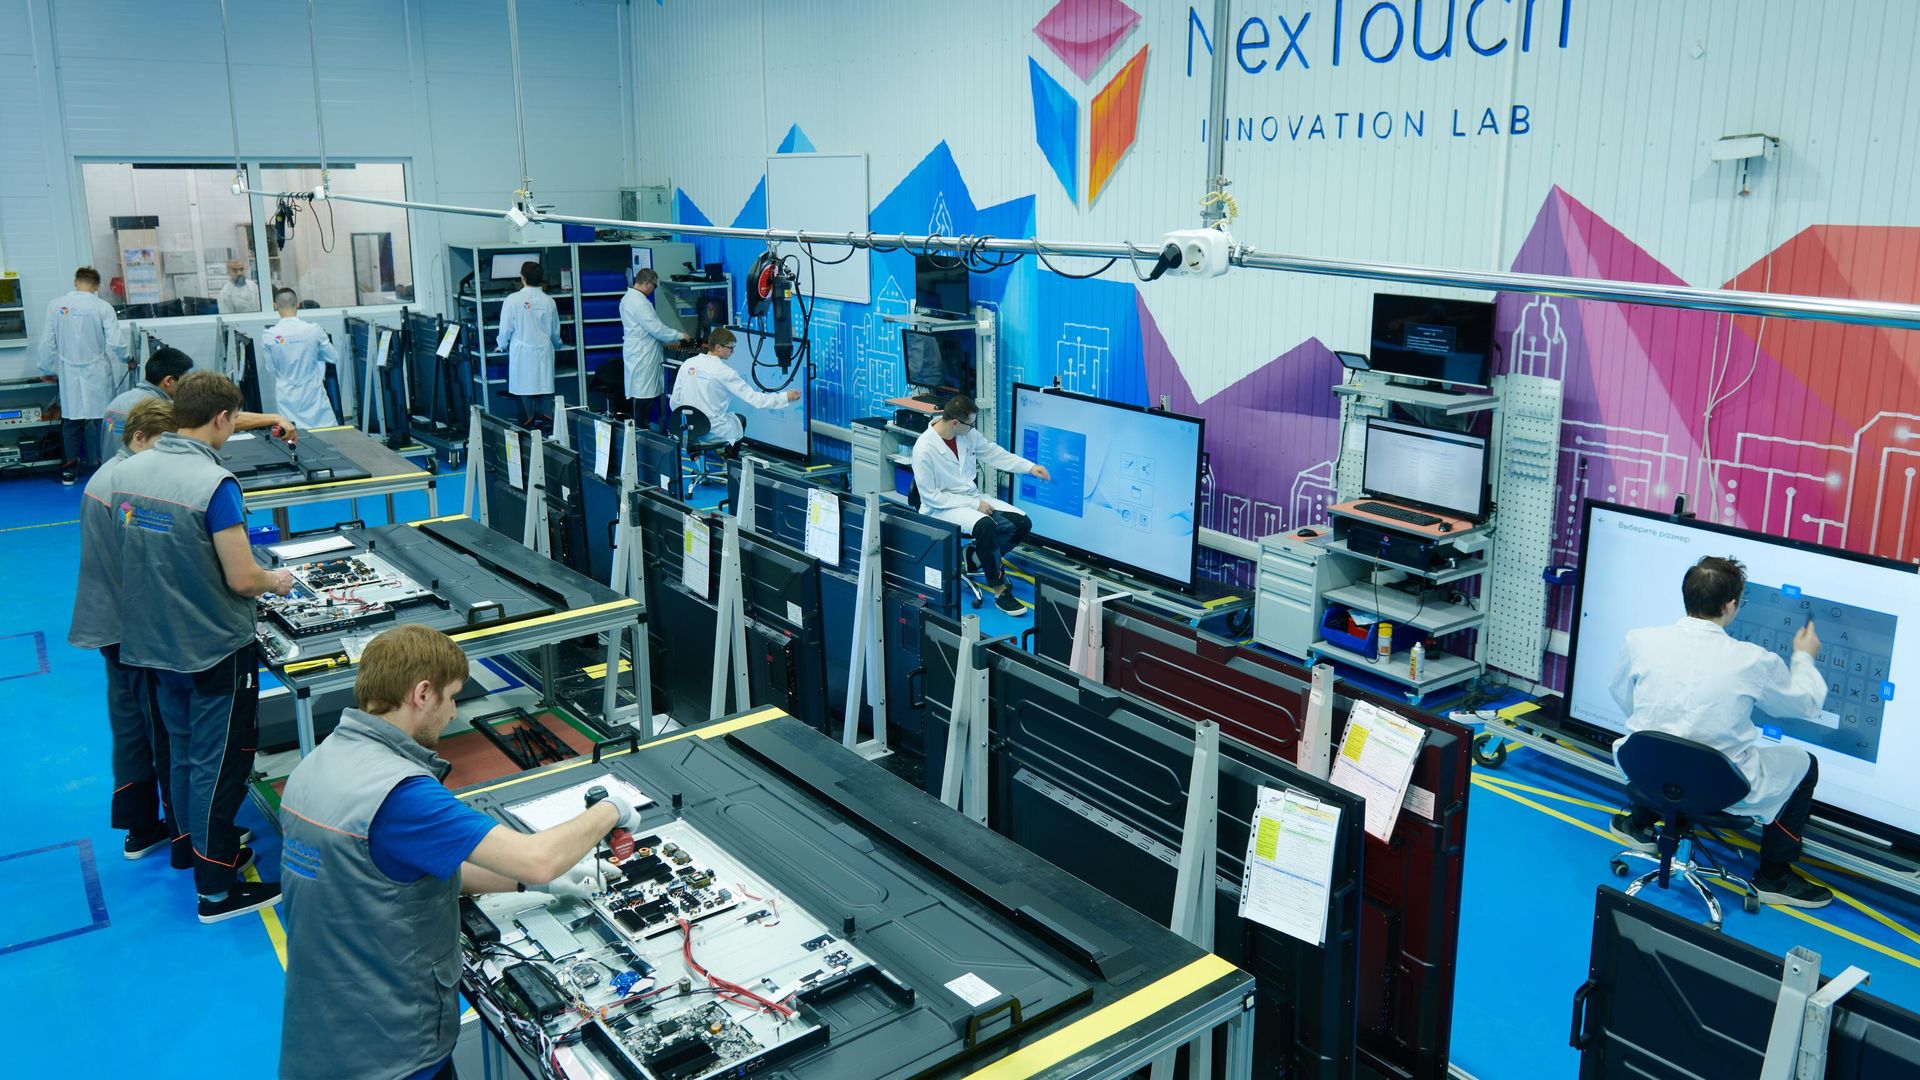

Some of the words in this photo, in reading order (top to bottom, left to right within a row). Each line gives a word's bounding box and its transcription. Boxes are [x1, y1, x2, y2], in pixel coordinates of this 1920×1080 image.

[1452, 105, 1530, 137] LAB
[1618, 521, 1657, 536] Выберите
[1659, 531, 1691, 543] размер
